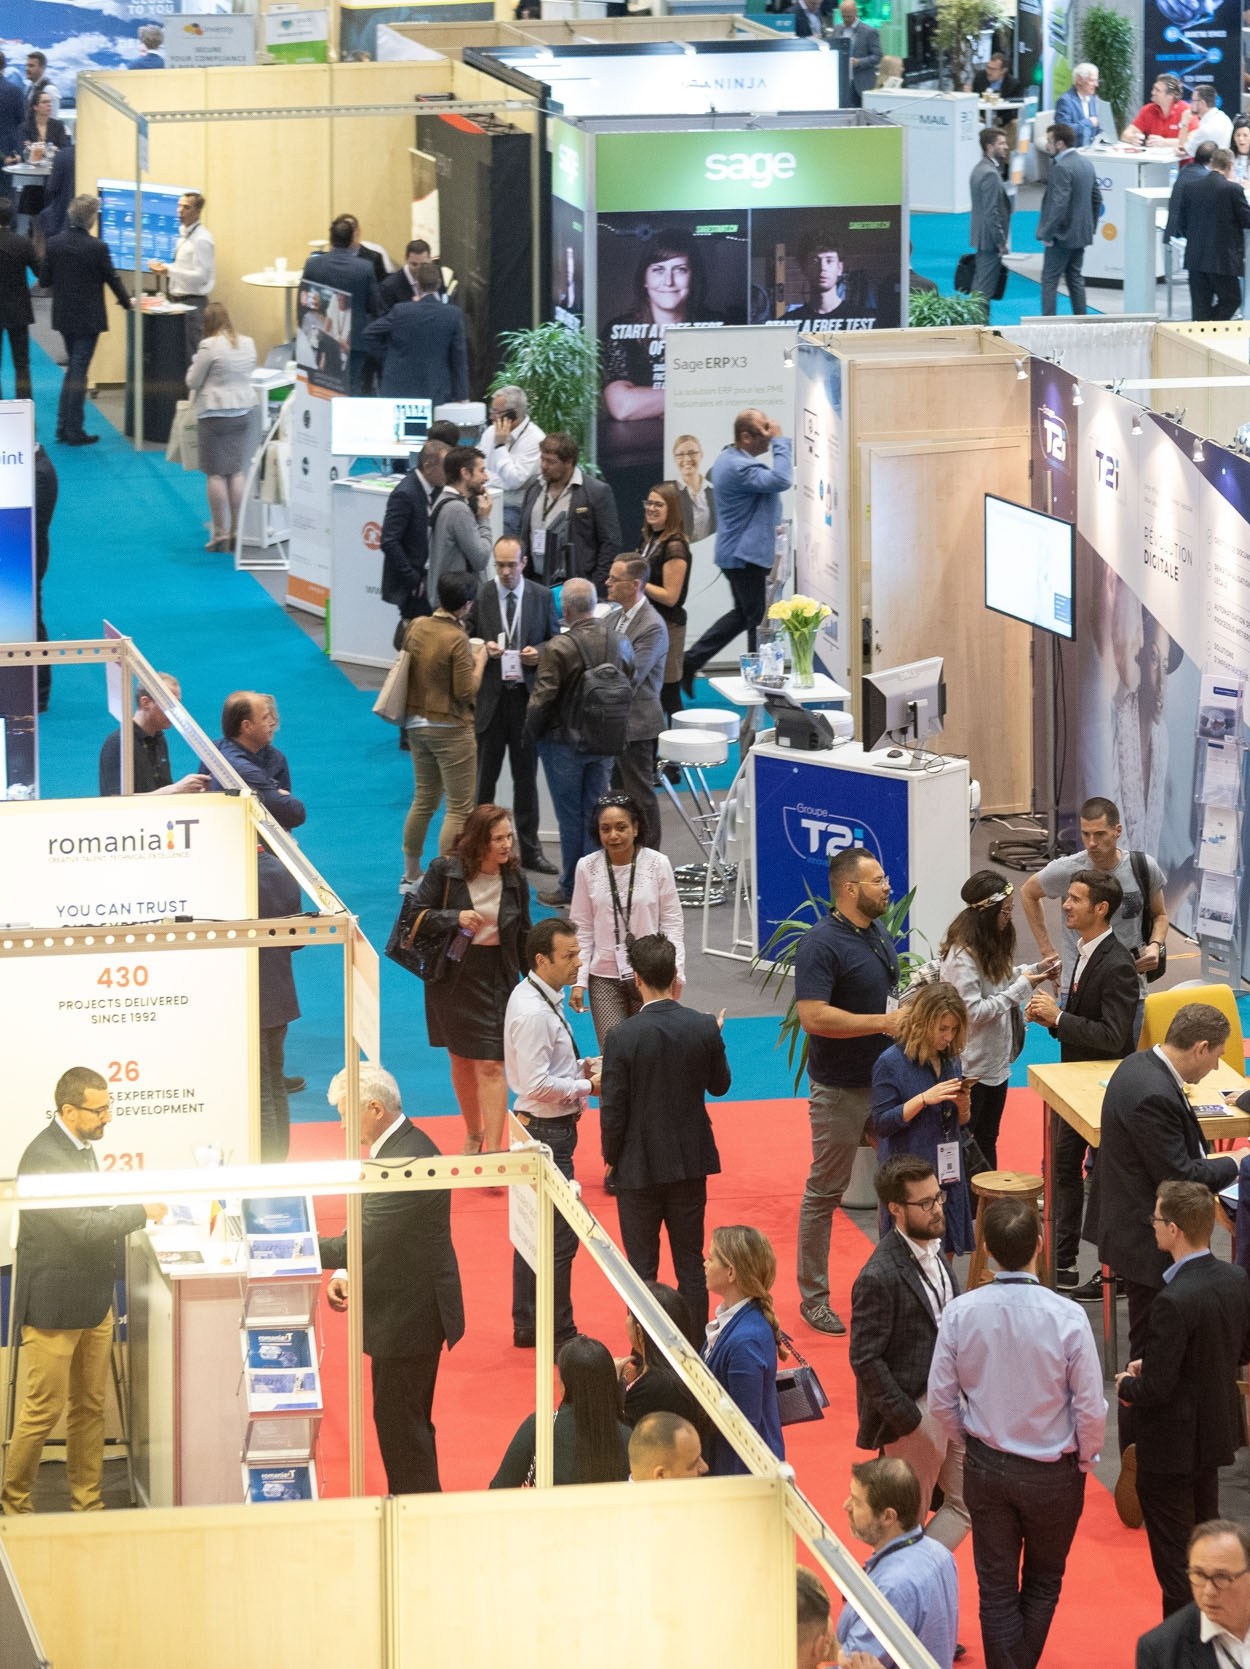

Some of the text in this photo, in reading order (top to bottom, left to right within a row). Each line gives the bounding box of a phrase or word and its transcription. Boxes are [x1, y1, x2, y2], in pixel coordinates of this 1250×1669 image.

[128, 4, 174, 14] TO YOU
[703, 152, 798, 189] sage
[610, 324, 649, 340] START
[649, 325, 657, 338] A
[814, 319, 844, 333] FREE
[845, 318, 876, 332] TEST
[672, 357, 704, 373] Sage
[1095, 449, 1120, 491] T2i
[1143, 549, 1180, 583] DIGITALE
[795, 802, 829, 818] Groupe
[800, 818, 865, 857] T2i
[56, 899, 188, 918] YOU CAN TRUST
[97, 965, 149, 989] 430
[58, 995, 189, 1011] PROJECTS DELIVERED
[91, 1011, 157, 1025] SINCE 1992
[107, 1060, 140, 1083] 26
[116, 1088, 195, 1101] EXPERTISE IN
[116, 1102, 205, 1117] DEVELOPMENT
[103, 1152, 144, 1173] 231
